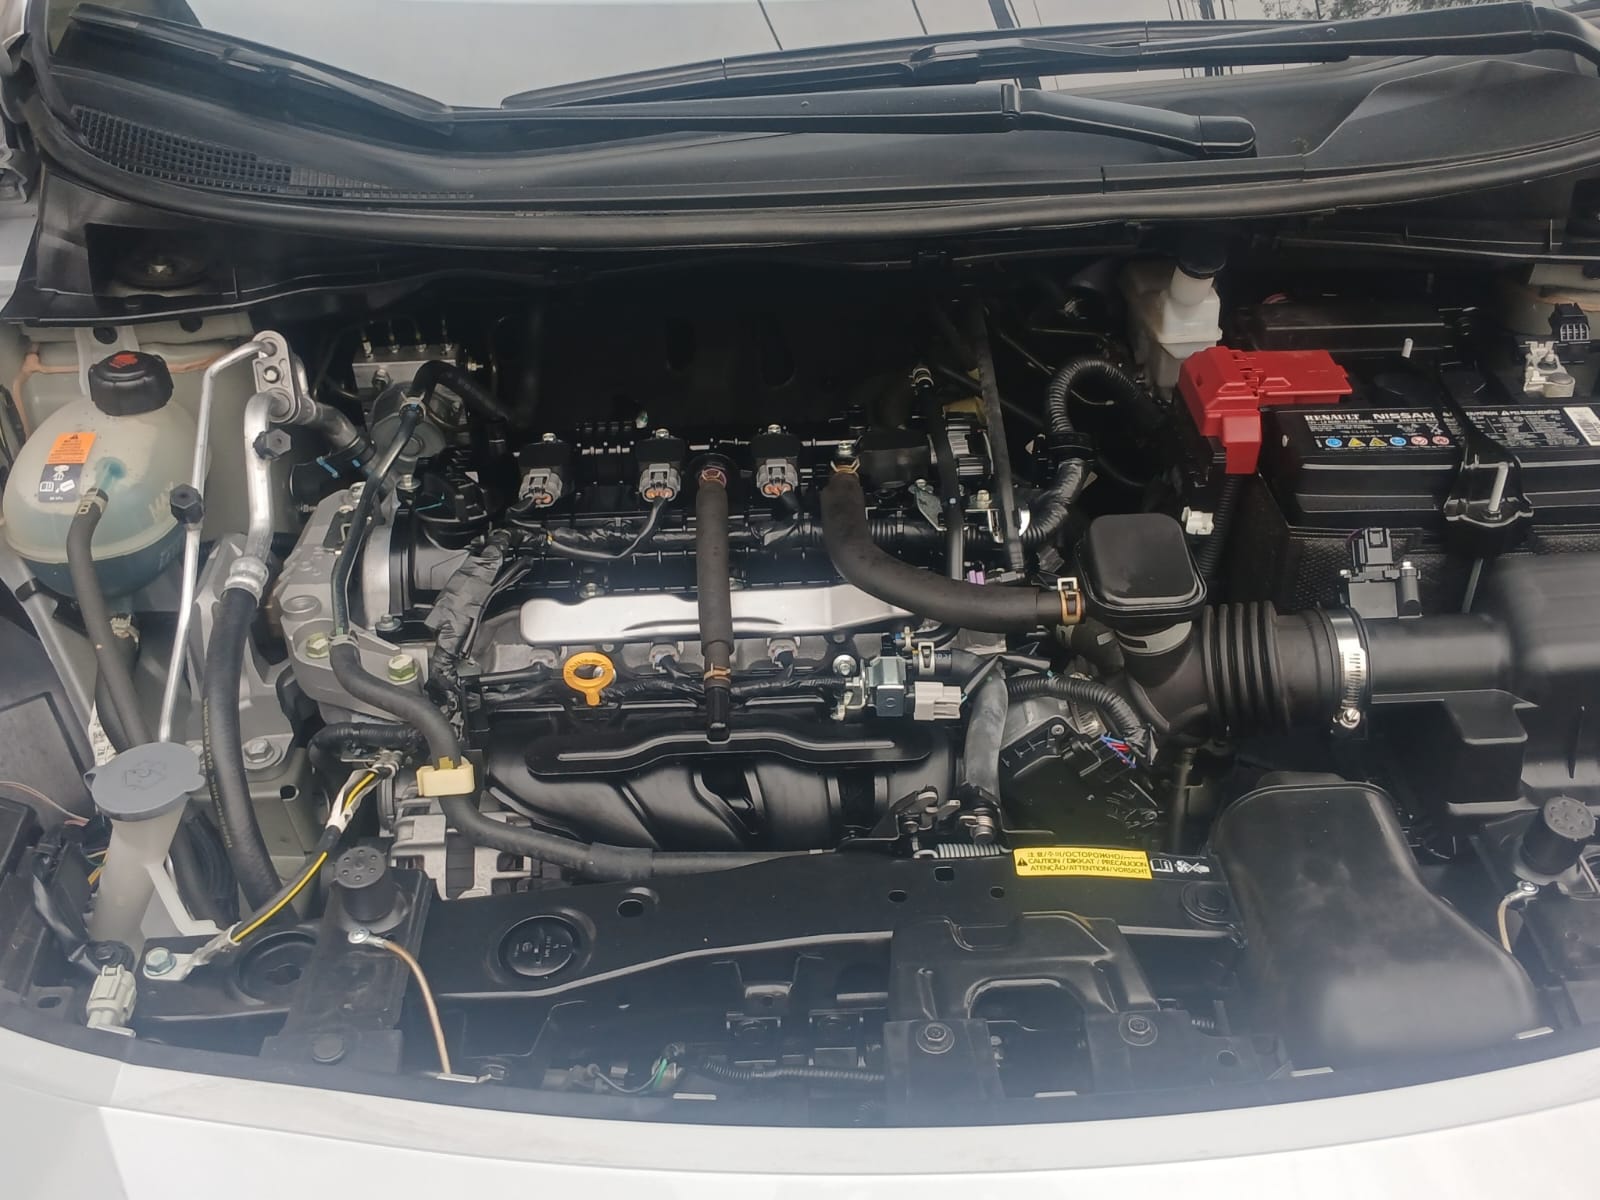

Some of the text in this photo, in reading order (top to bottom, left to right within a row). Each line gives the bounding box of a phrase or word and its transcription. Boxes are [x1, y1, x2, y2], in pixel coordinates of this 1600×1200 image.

[1304, 412, 1436, 421] RENAULT NISSAN
[1028, 857, 1061, 865] CAUTION
